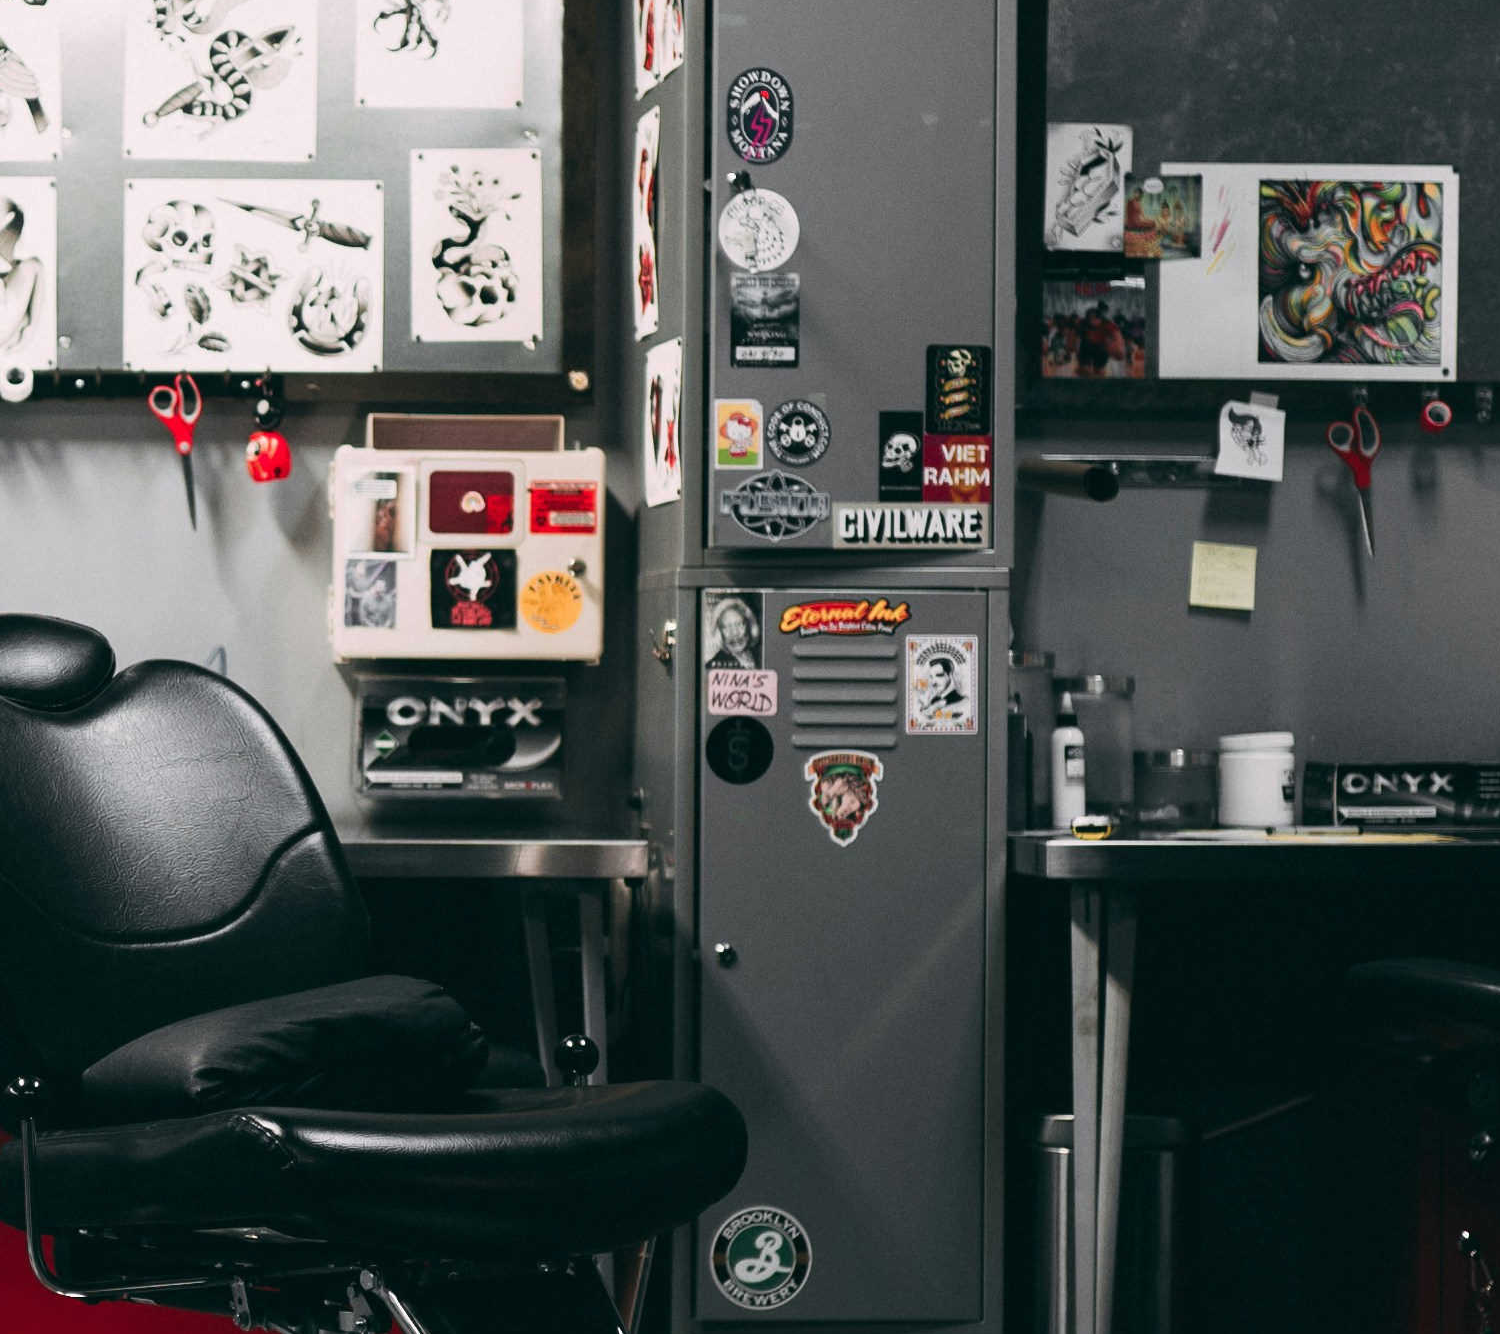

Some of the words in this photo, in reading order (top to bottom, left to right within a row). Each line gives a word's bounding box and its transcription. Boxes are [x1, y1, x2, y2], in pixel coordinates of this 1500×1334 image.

[729, 70, 791, 112] SHOWDOWN
[730, 128, 789, 160] MONTANA
[941, 443, 988, 463] VIET
[924, 467, 991, 487] RAHM
[839, 508, 982, 542] CIVILWARE
[780, 600, 867, 633] Eternal
[867, 598, 909, 622] Ink
[711, 672, 769, 689] NINA'S
[386, 695, 544, 727] ONYX
[711, 691, 773, 713] WORLD
[1342, 770, 1454, 795] ONYX
[722, 1211, 801, 1241] BROOKLYN
[722, 1277, 799, 1307] BREWERY
